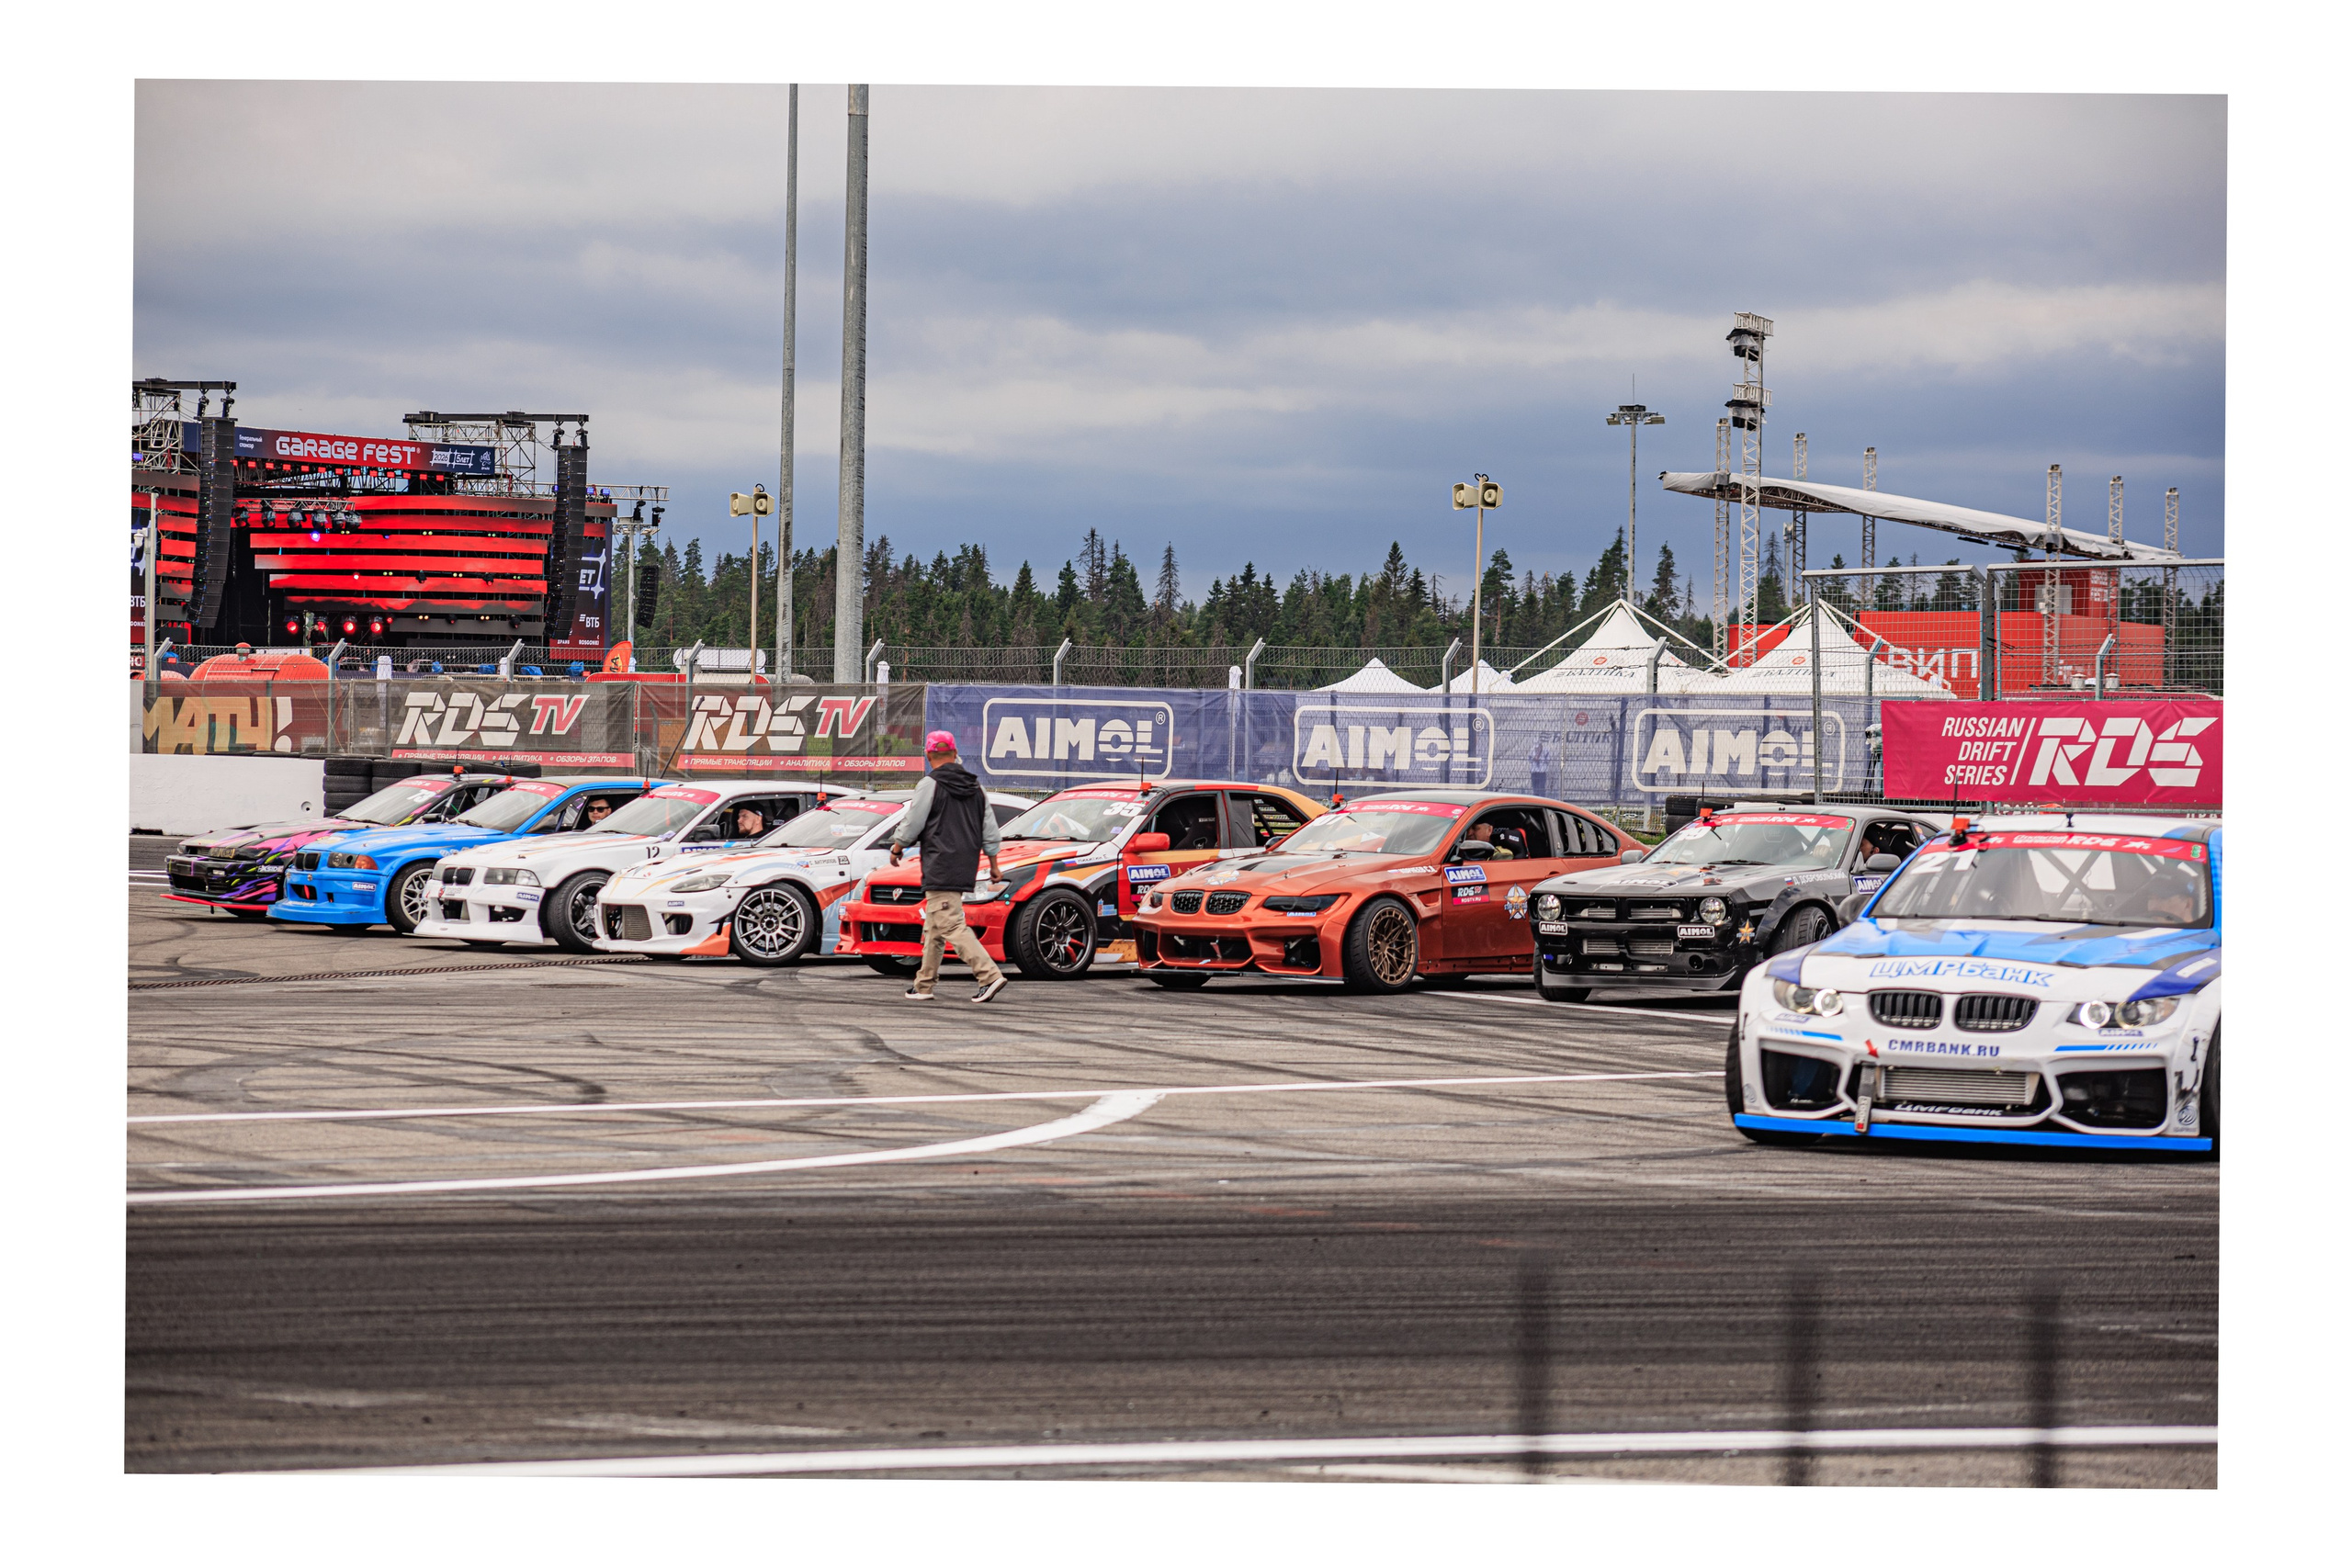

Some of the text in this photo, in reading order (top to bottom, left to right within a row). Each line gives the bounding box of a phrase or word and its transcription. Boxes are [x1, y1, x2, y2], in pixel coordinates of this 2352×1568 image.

[585, 616, 600, 628] ВТБ
[1887, 646, 1979, 680] ВИП
[1565, 669, 1635, 678] БАЛТИКА
[1763, 668, 1836, 678] БАЛТИА
[396, 692, 591, 747] RDS TV
[683, 695, 878, 751] RDS TV
[989, 716, 1164, 763] AIMOL
[1301, 724, 1482, 772] AIMOL
[1941, 716, 2219, 787] RUSSIAN RDS
[1958, 740, 2018, 761] DRIFT
[498, 754, 543, 762] АНАЛИТИКА
[556, 755, 588, 763] ОБЗОРЫ
[587, 756, 617, 764] ЭТАПОВ
[690, 758, 906, 768] ПРЯМЫЕ ТРАНСЛЯЦИИ АНАЛИТИКА ОБЗОРЫ ЭТАПОВ
[1944, 764, 2007, 785] SERIES
[1102, 801, 1147, 818] 35
[2066, 835, 2120, 847] RDS
[645, 845, 661, 860] 12
[1910, 848, 1979, 874] 21
[1130, 868, 1169, 879] AIMOL
[1450, 868, 1485, 881] AIMOL
[1457, 886, 1475, 897] RDS
[1541, 923, 1566, 933] AIMOL
[1679, 928, 1713, 936] AIMOL
[1888, 1039, 2001, 1057] CMRBANK.RU
